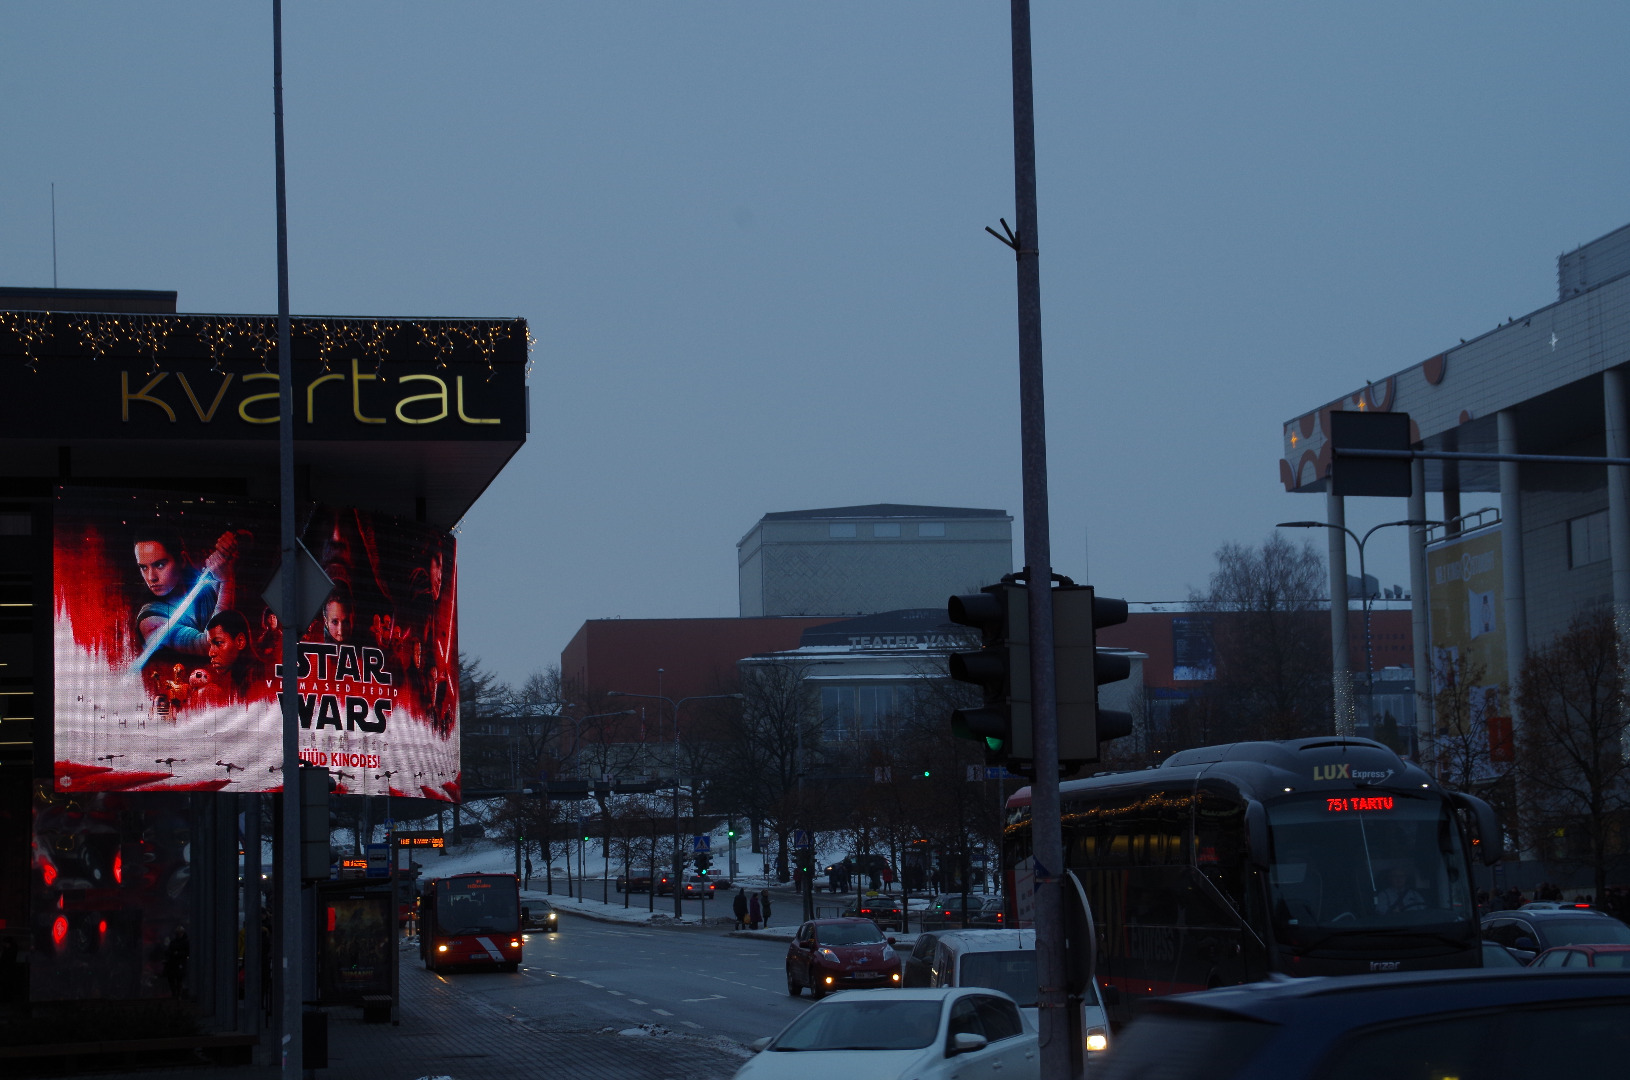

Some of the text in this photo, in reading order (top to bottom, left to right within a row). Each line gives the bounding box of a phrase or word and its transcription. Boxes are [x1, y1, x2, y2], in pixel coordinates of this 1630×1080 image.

[848, 636, 918, 649] TEATER
[275, 641, 392, 686] STAR
[266, 680, 398, 697] VIMASED JEDID
[275, 691, 392, 733] WARS
[331, 752, 381, 769] KINODES!
[1313, 763, 1385, 781] LUX Express
[1326, 796, 1393, 812] 751 TARTU
